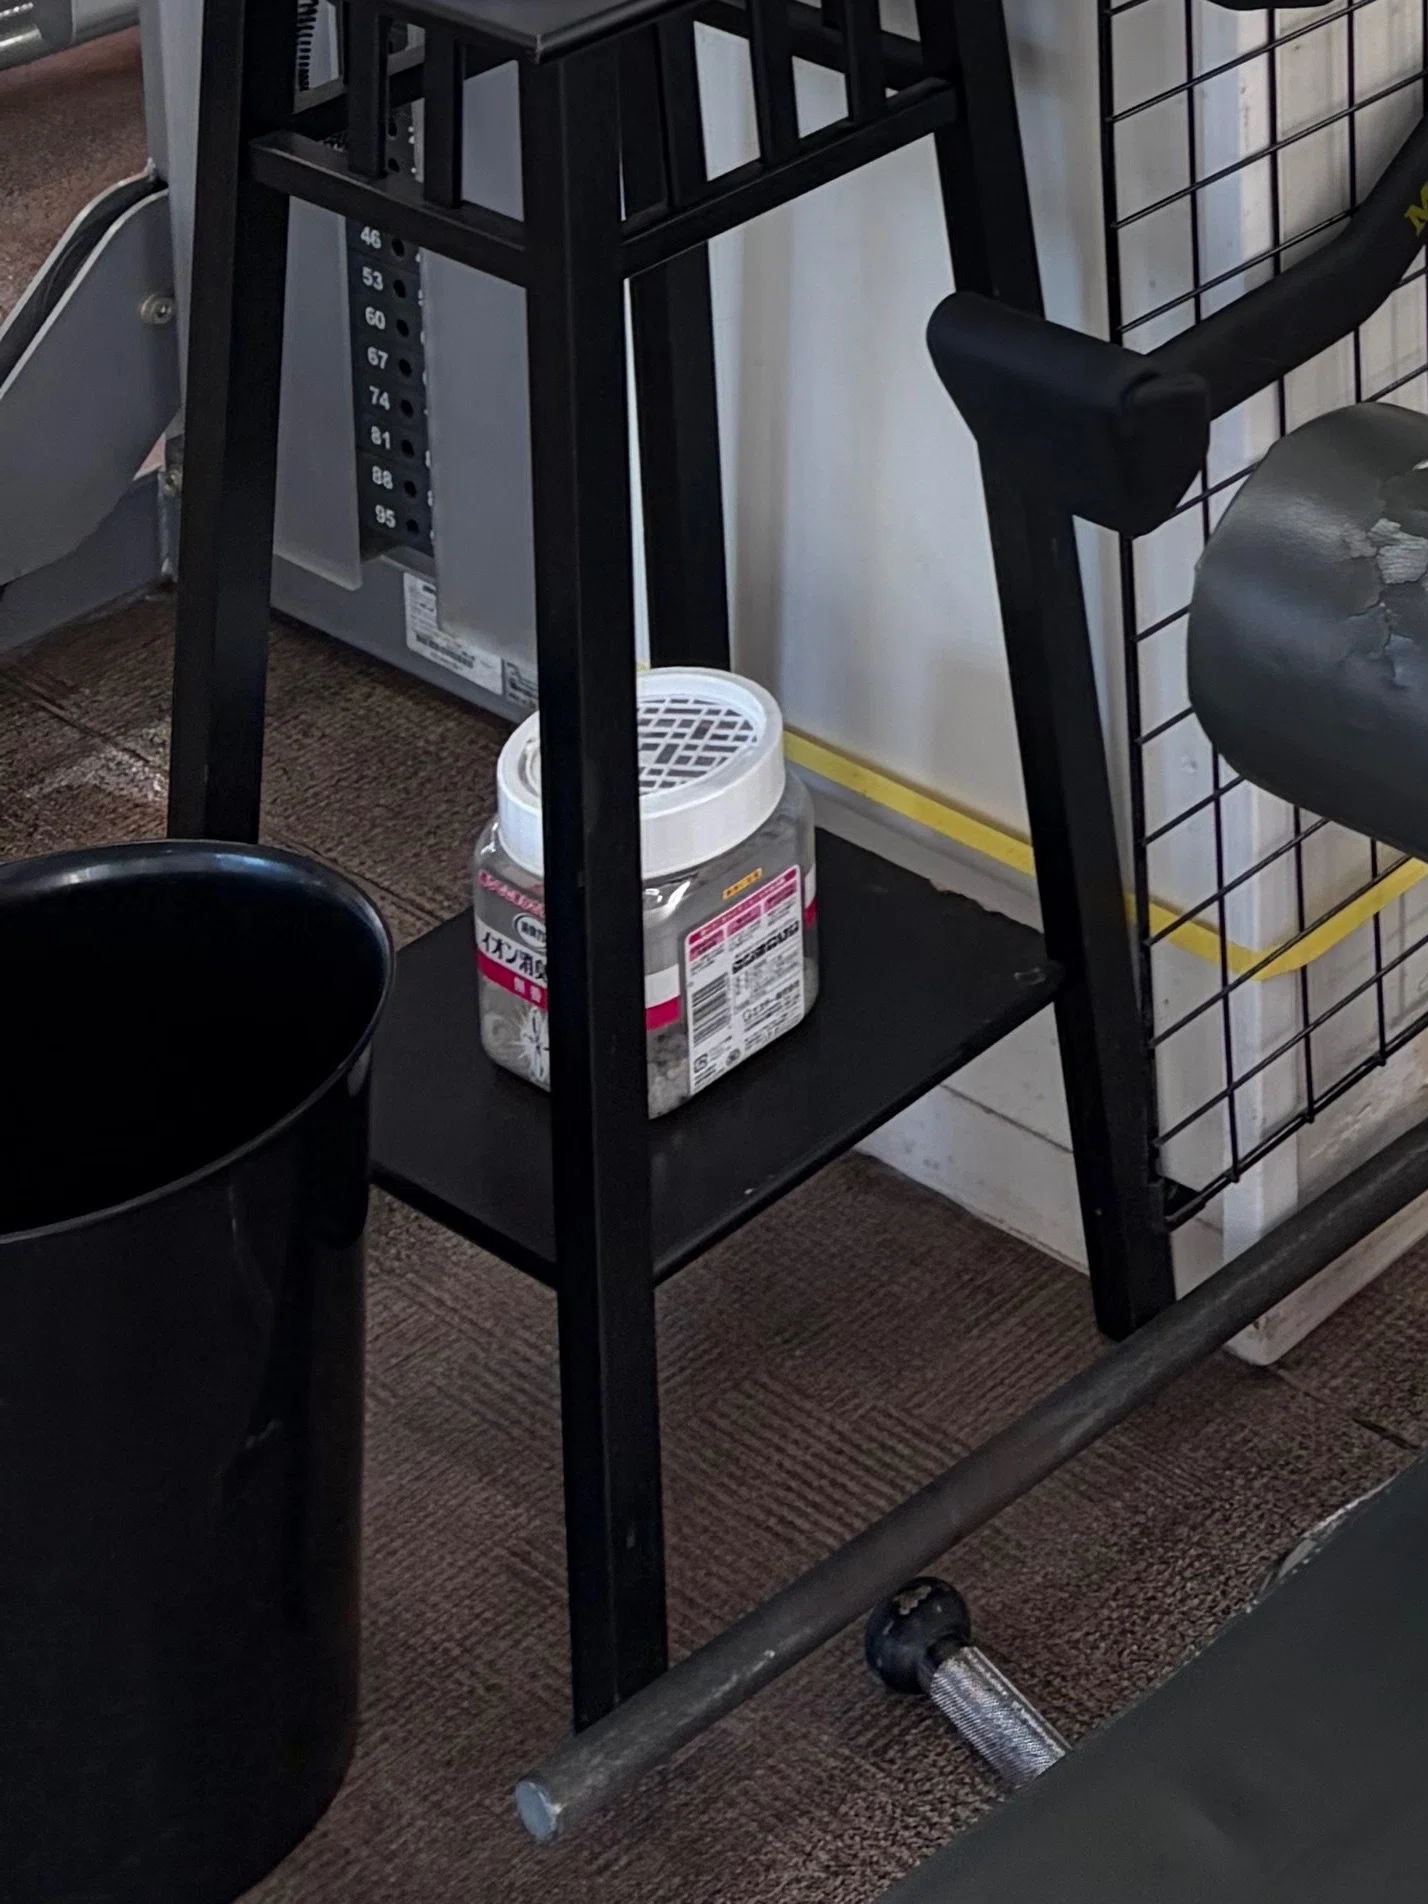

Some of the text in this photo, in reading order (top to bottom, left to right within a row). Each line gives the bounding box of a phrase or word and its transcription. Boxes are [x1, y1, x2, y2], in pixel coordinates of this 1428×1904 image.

[360, 226, 381, 249] 46
[362, 266, 384, 291] 53
[365, 306, 386, 330] 60
[367, 346, 389, 370] 67
[369, 385, 390, 410] 74
[370, 425, 391, 450] 81
[372, 465, 394, 490] 88
[375, 504, 396, 528] 95
